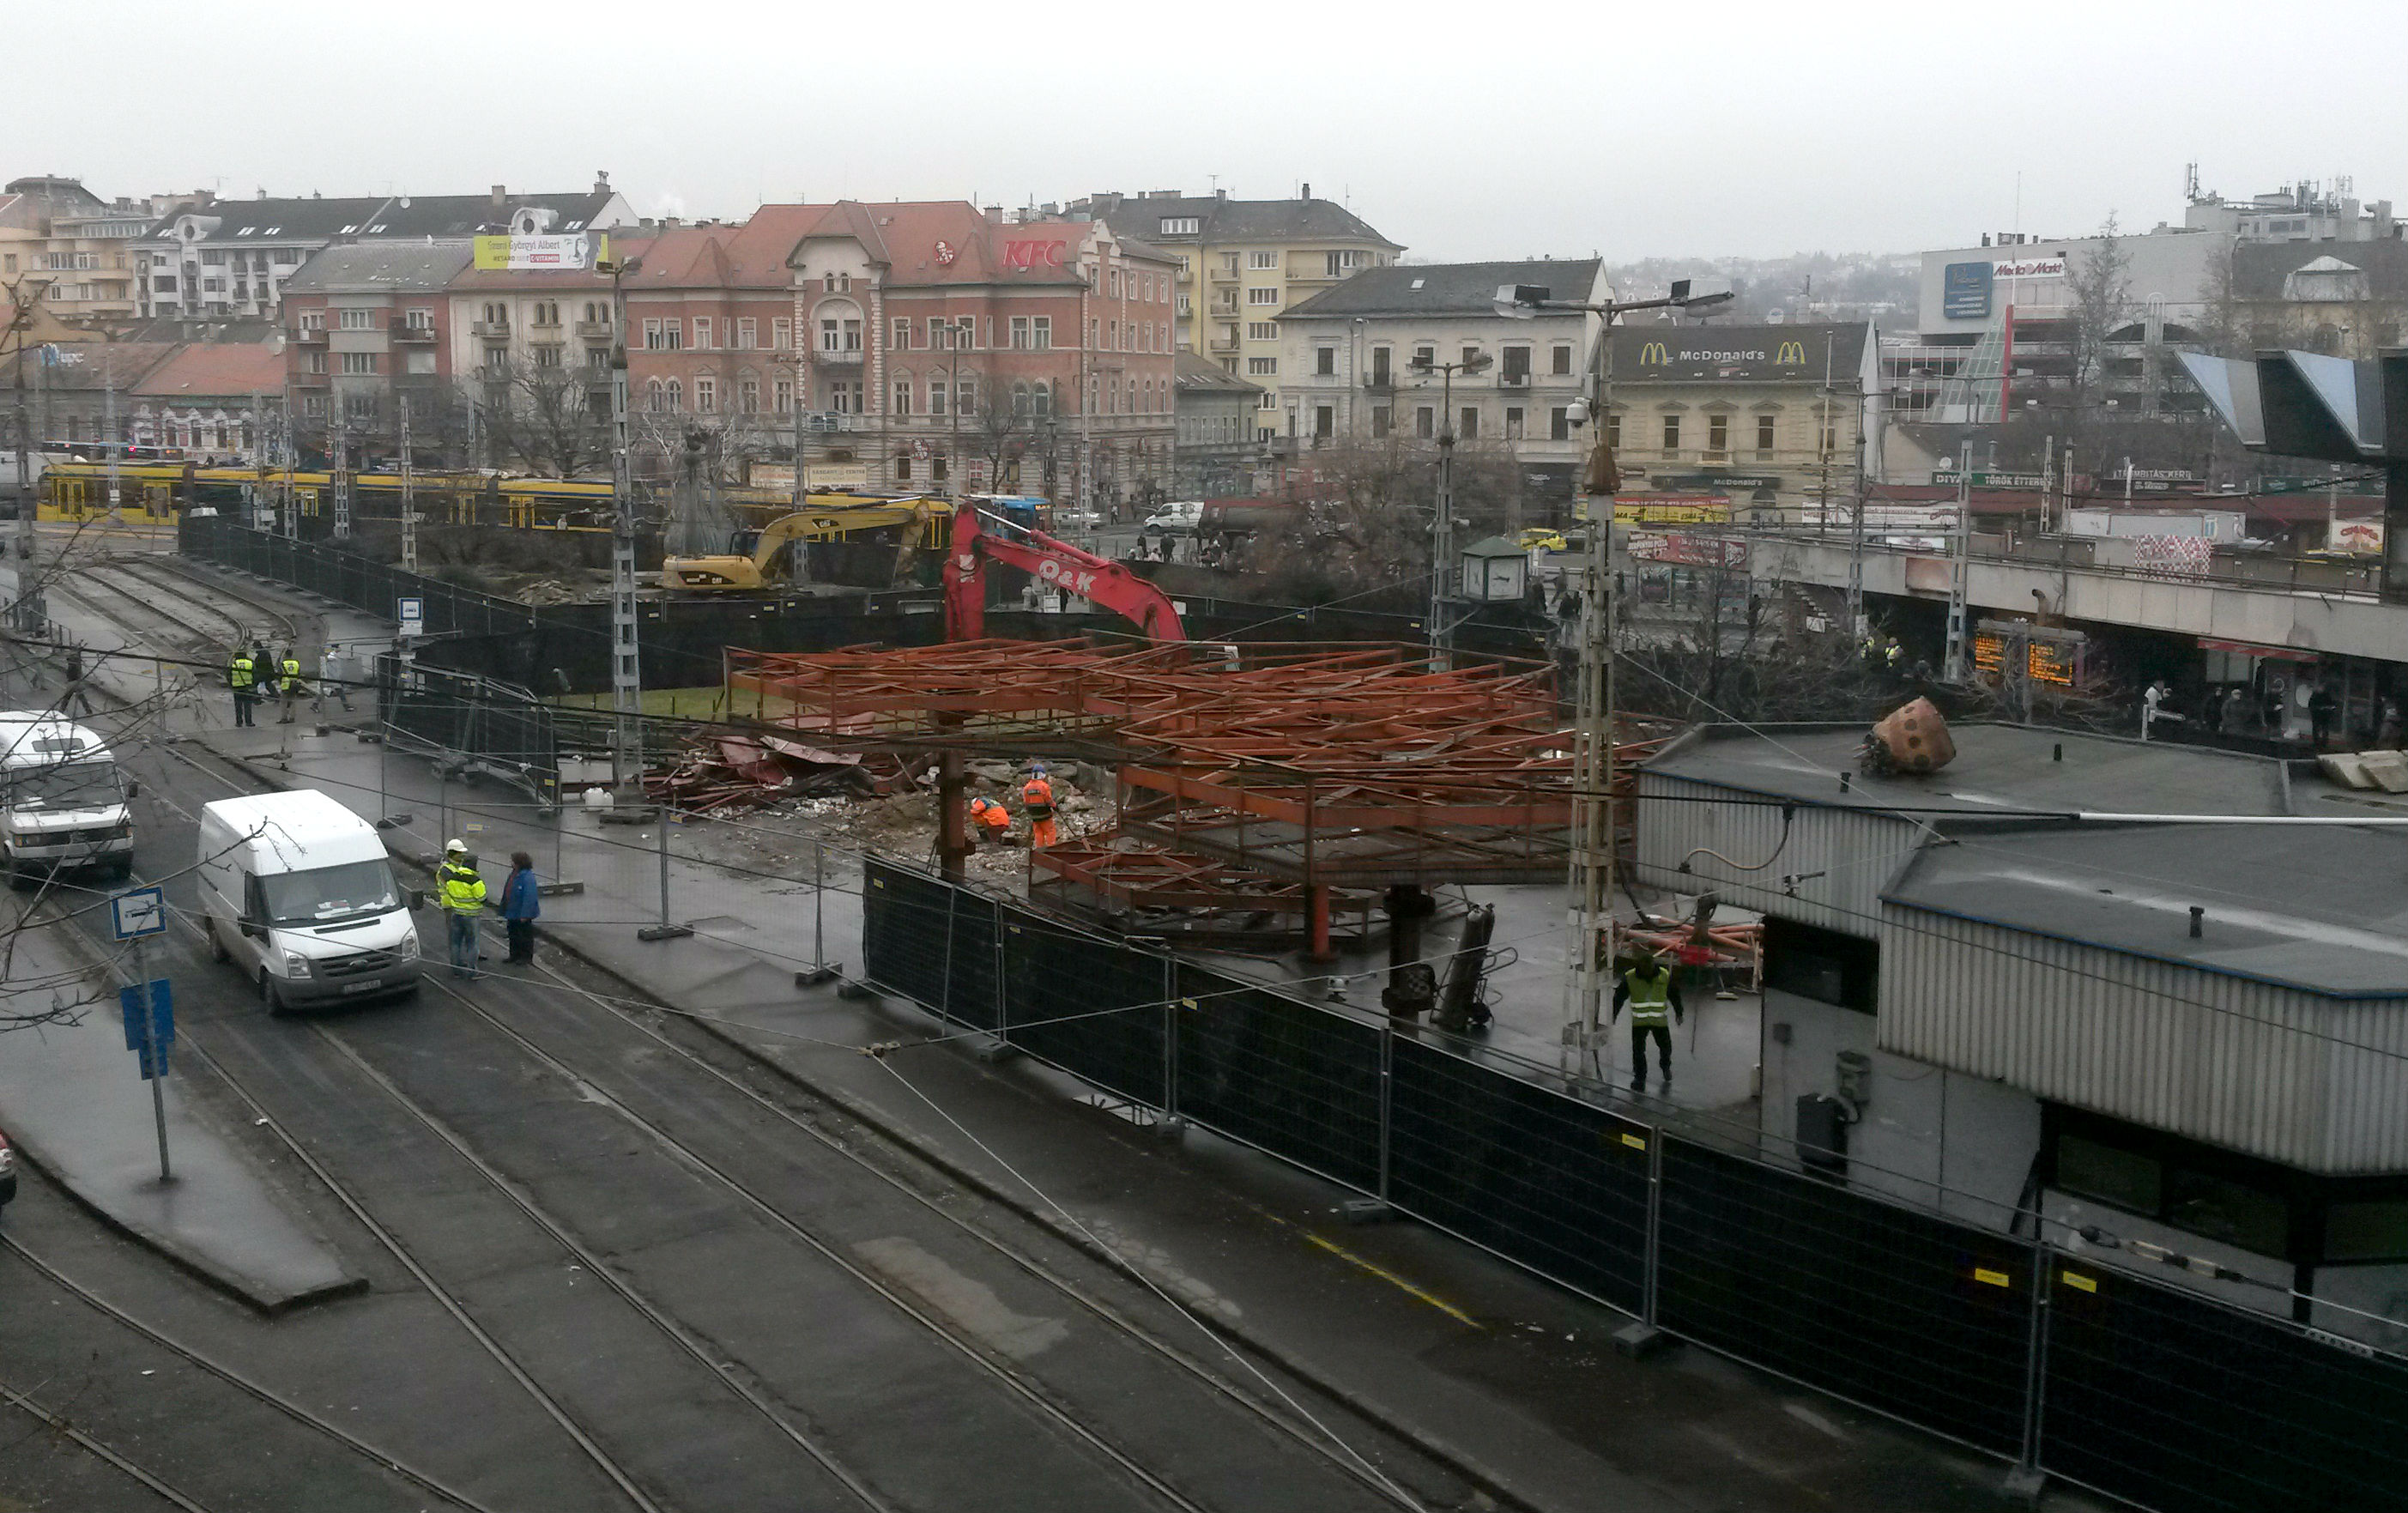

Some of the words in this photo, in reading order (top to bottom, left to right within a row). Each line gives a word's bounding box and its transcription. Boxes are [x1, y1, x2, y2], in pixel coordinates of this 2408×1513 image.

[510, 240, 536, 251] Györgyi
[538, 240, 560, 250] Albert
[1002, 240, 1067, 267] KFC
[1679, 349, 1765, 361] McDonald's
[1713, 478, 1764, 487] McDonald's
[1985, 474, 2012, 486] TÖRÖK
[1039, 560, 1098, 592] O&K
